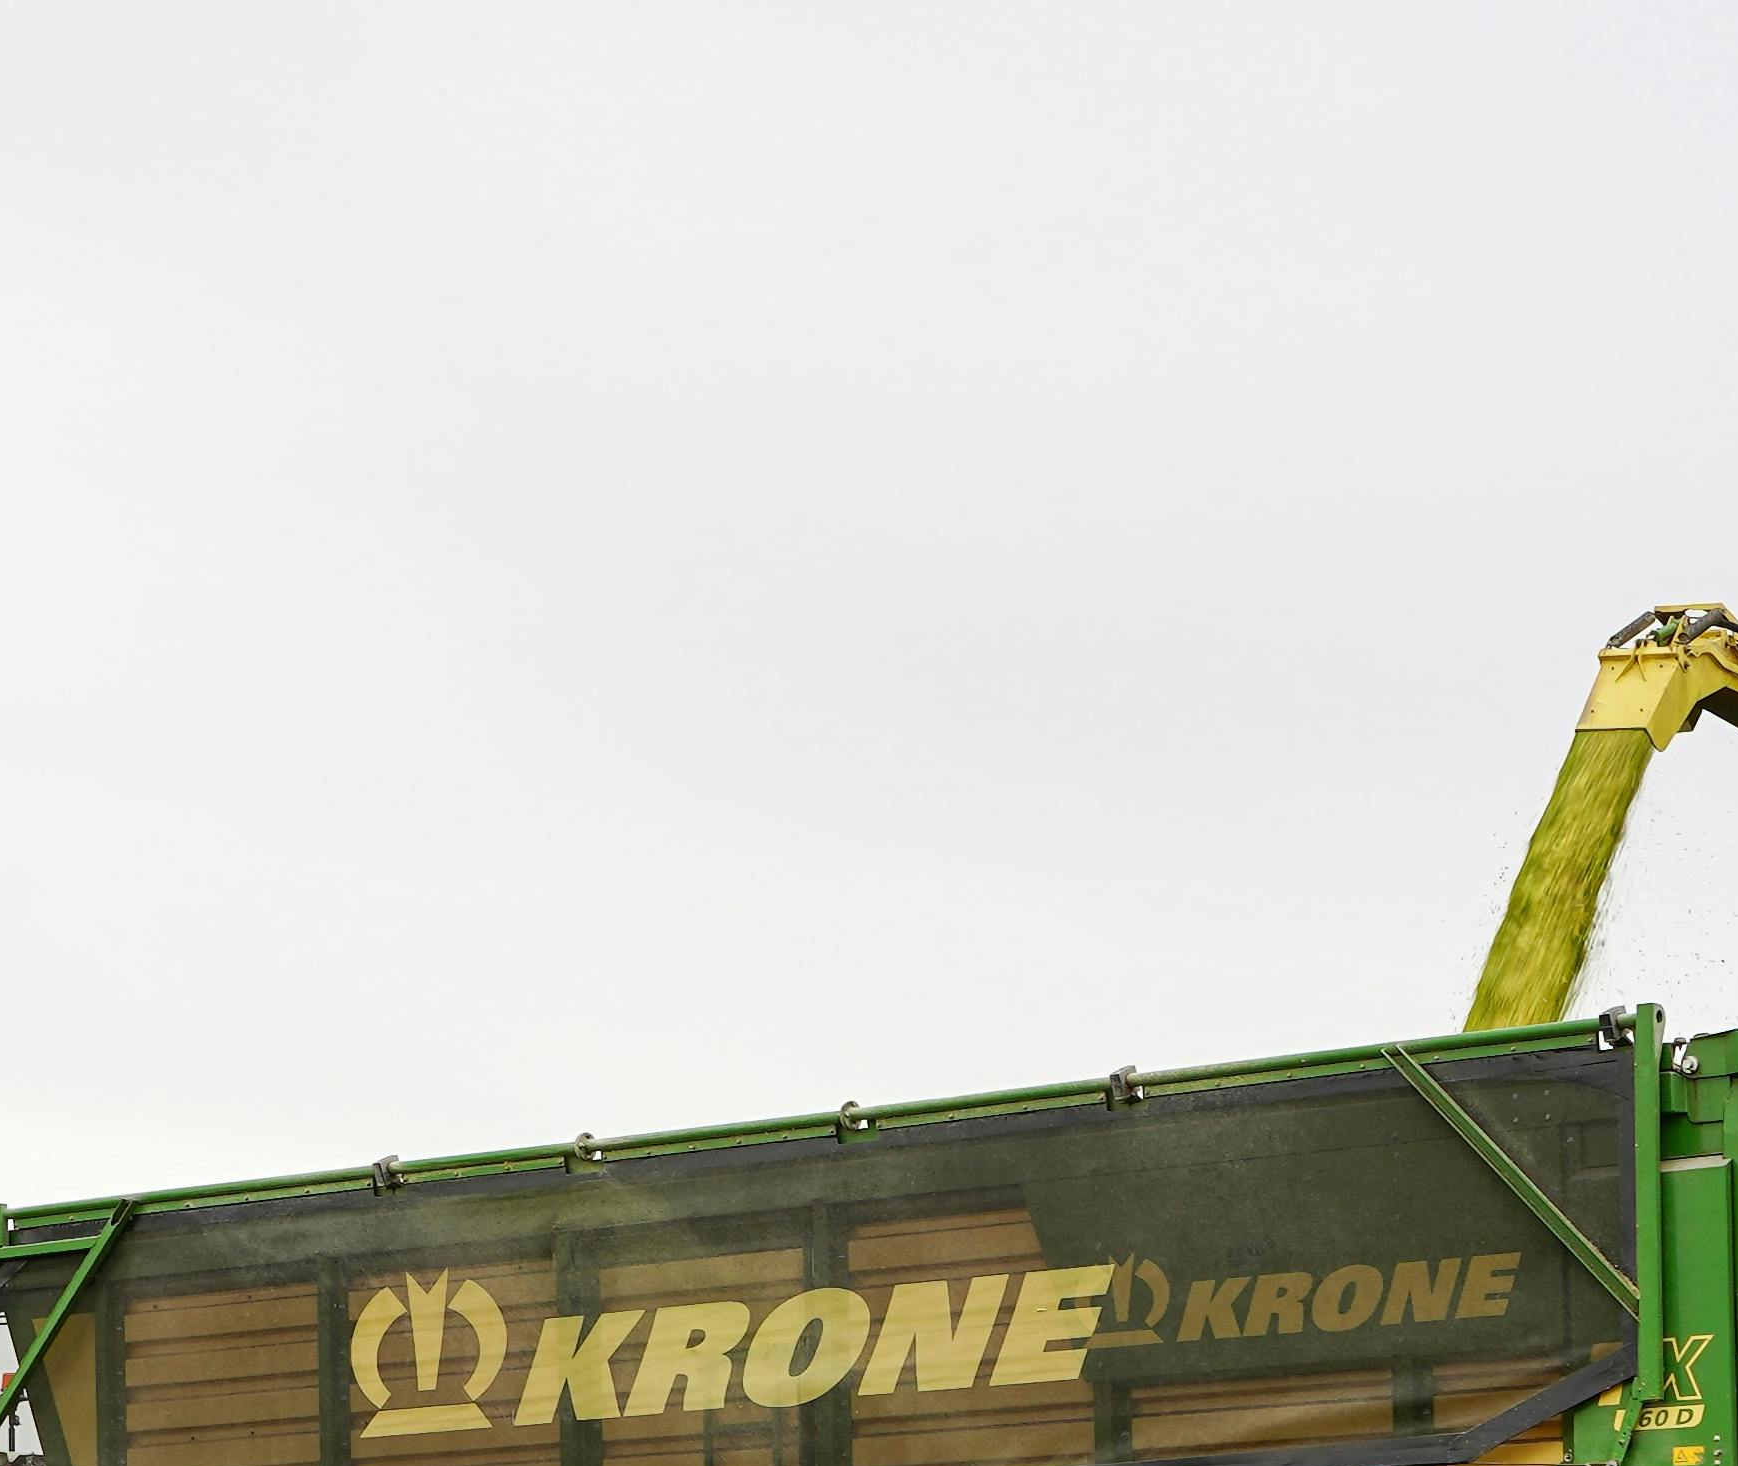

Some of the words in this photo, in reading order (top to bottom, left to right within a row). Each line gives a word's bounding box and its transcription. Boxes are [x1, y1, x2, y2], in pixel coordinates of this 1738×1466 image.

[1176, 1251, 1522, 1342] KRONE
[513, 1263, 1115, 1427] KRONE
[1675, 1408, 1694, 1425] D
